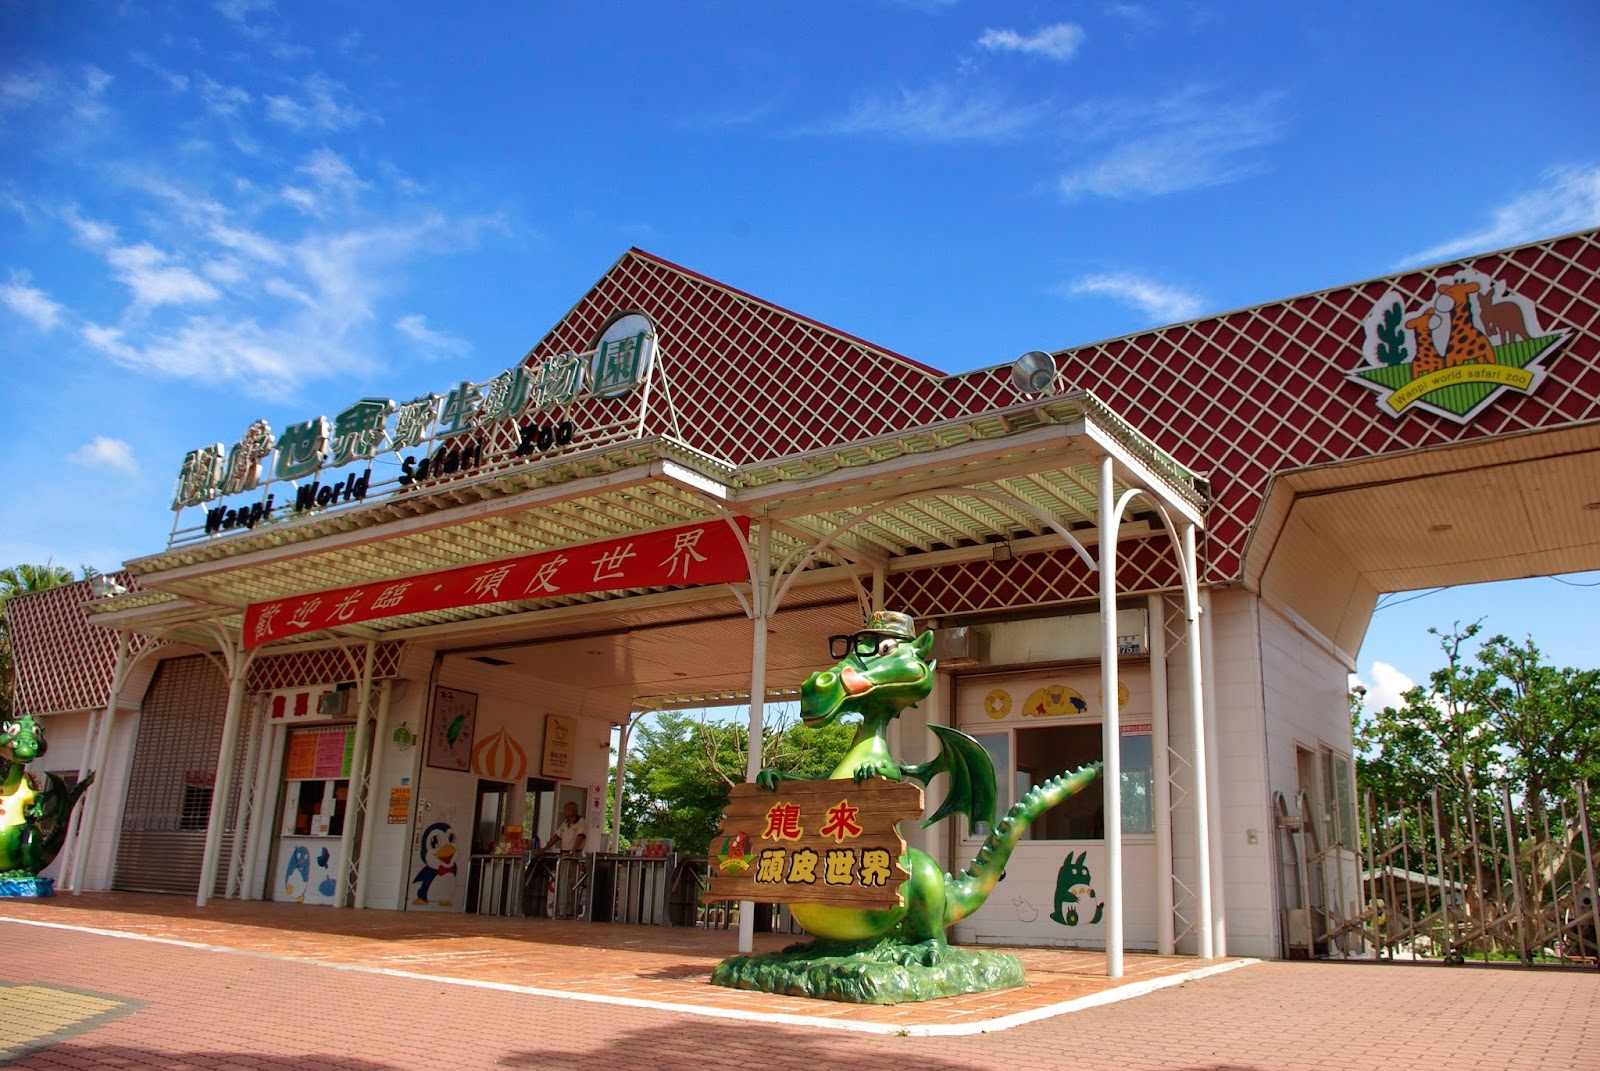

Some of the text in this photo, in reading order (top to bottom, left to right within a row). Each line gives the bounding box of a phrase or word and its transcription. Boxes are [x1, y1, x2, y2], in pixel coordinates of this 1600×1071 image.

[1395, 367, 1527, 405] Wanpi world safari zoo
[205, 421, 574, 534] Wanpi World Safari Zoo
[755, 847, 893, 887] 頑皮世界
